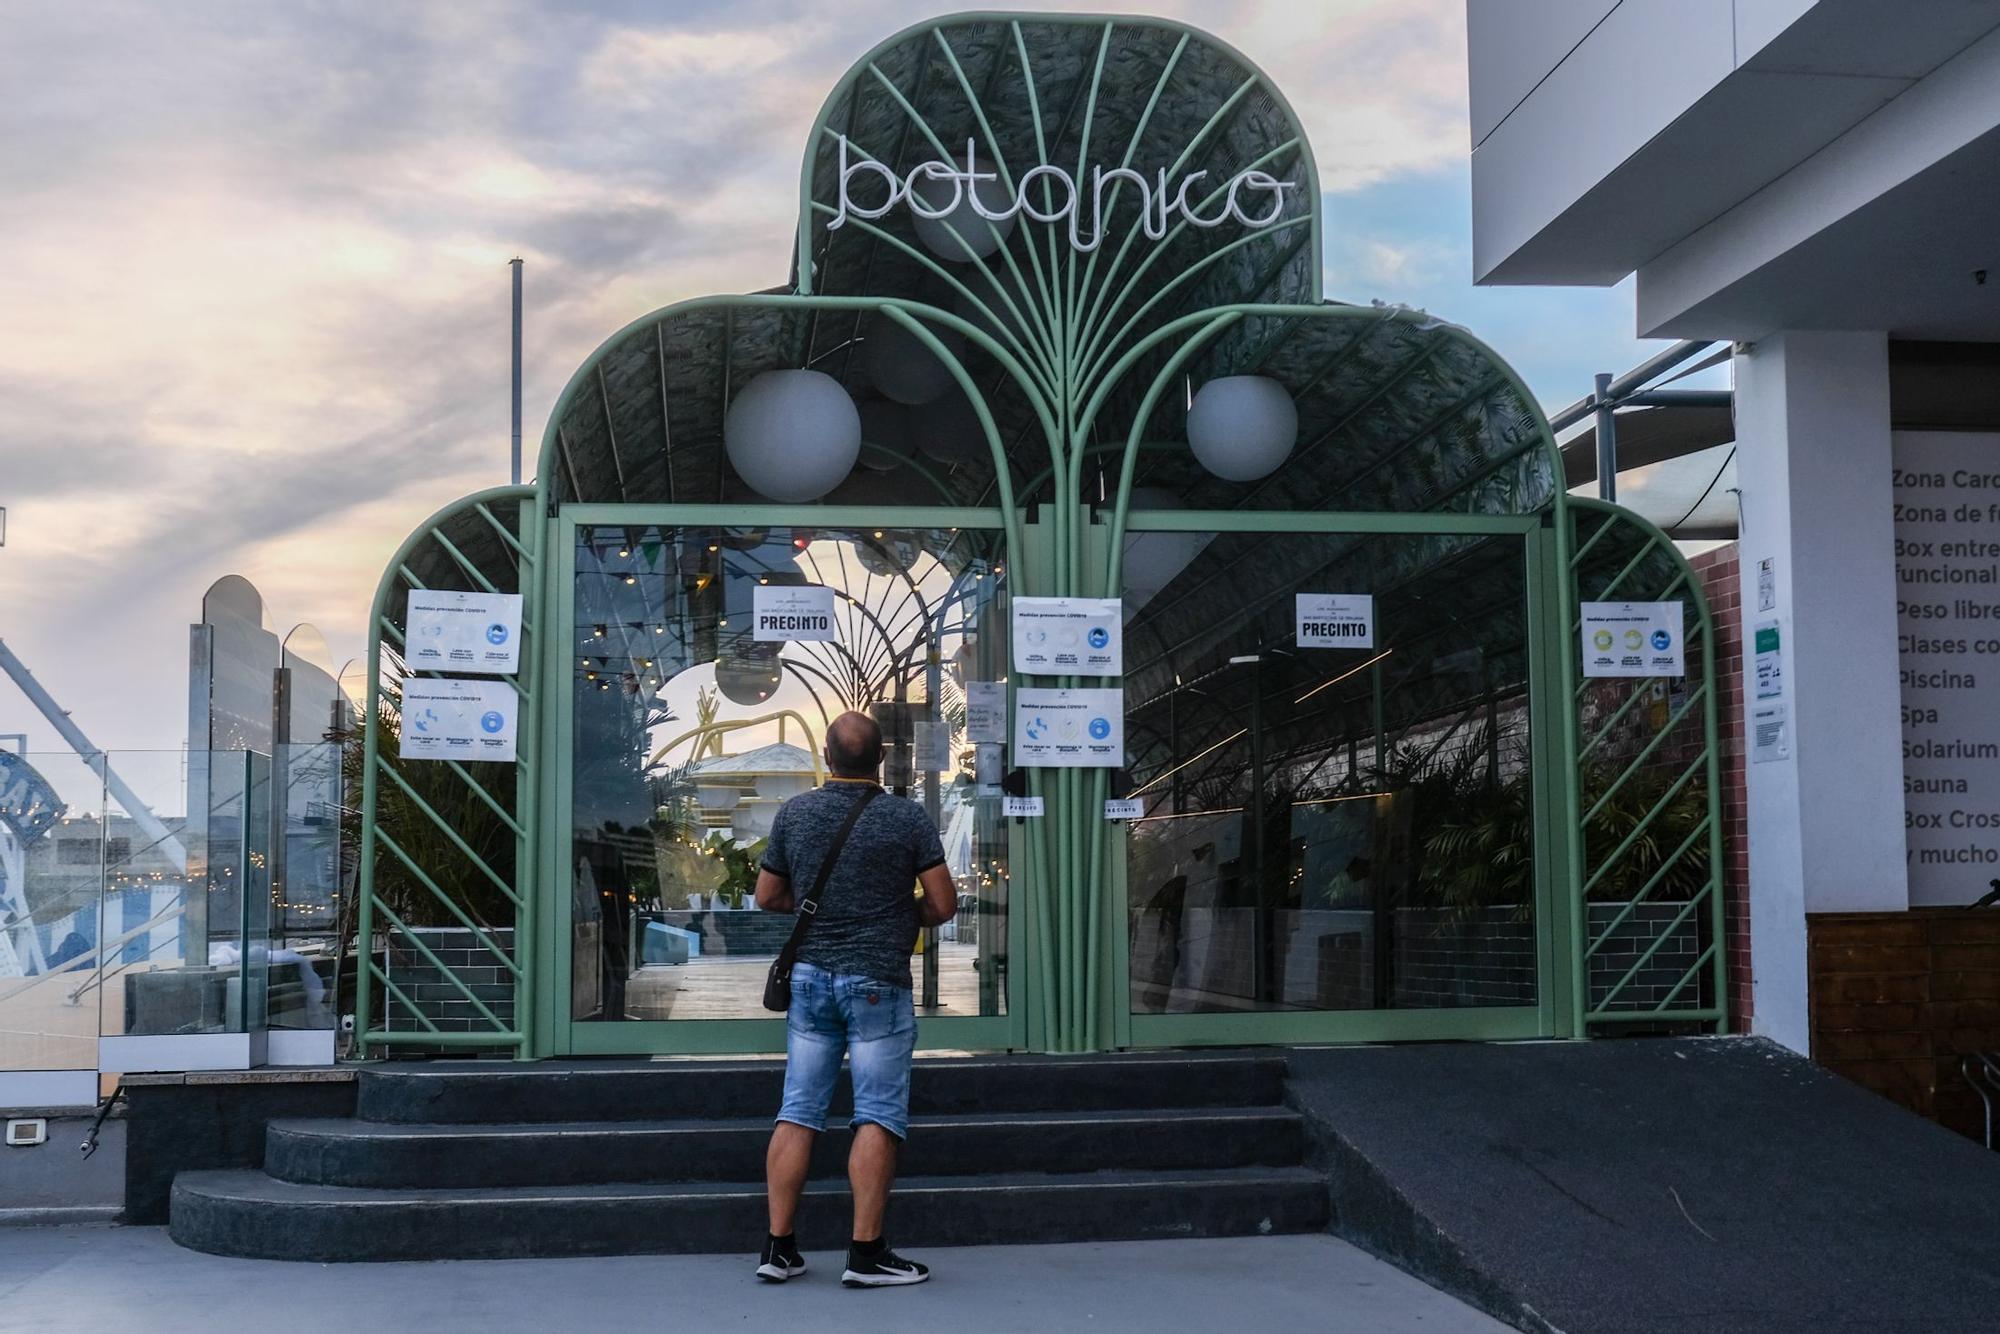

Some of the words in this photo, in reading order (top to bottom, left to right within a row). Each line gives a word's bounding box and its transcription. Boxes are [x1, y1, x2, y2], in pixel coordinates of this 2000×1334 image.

[826, 135, 1295, 252] botanico
[1892, 470, 1946, 488] Zona
[1893, 504, 1946, 522] Zona
[1954, 503, 1981, 522] de
[1988, 504, 2000, 522] f
[1894, 539, 1933, 557] Box
[1940, 539, 2000, 558] entre
[1897, 601, 1948, 619] Peso
[1954, 600, 2000, 619] libre
[760, 615, 828, 630] PRECINTO
[1303, 623, 1366, 637] PRECINTO
[1898, 634, 1967, 654] Clases
[1974, 639, 2000, 654] co
[1900, 669, 1976, 688] Piscina
[1901, 705, 1938, 728] Spa
[1902, 739, 1998, 758] Solarium
[1903, 776, 1968, 794] Sauna
[1905, 811, 1942, 829] Box
[1950, 810, 2000, 829] Cros
[1920, 844, 1998, 864] mucho
